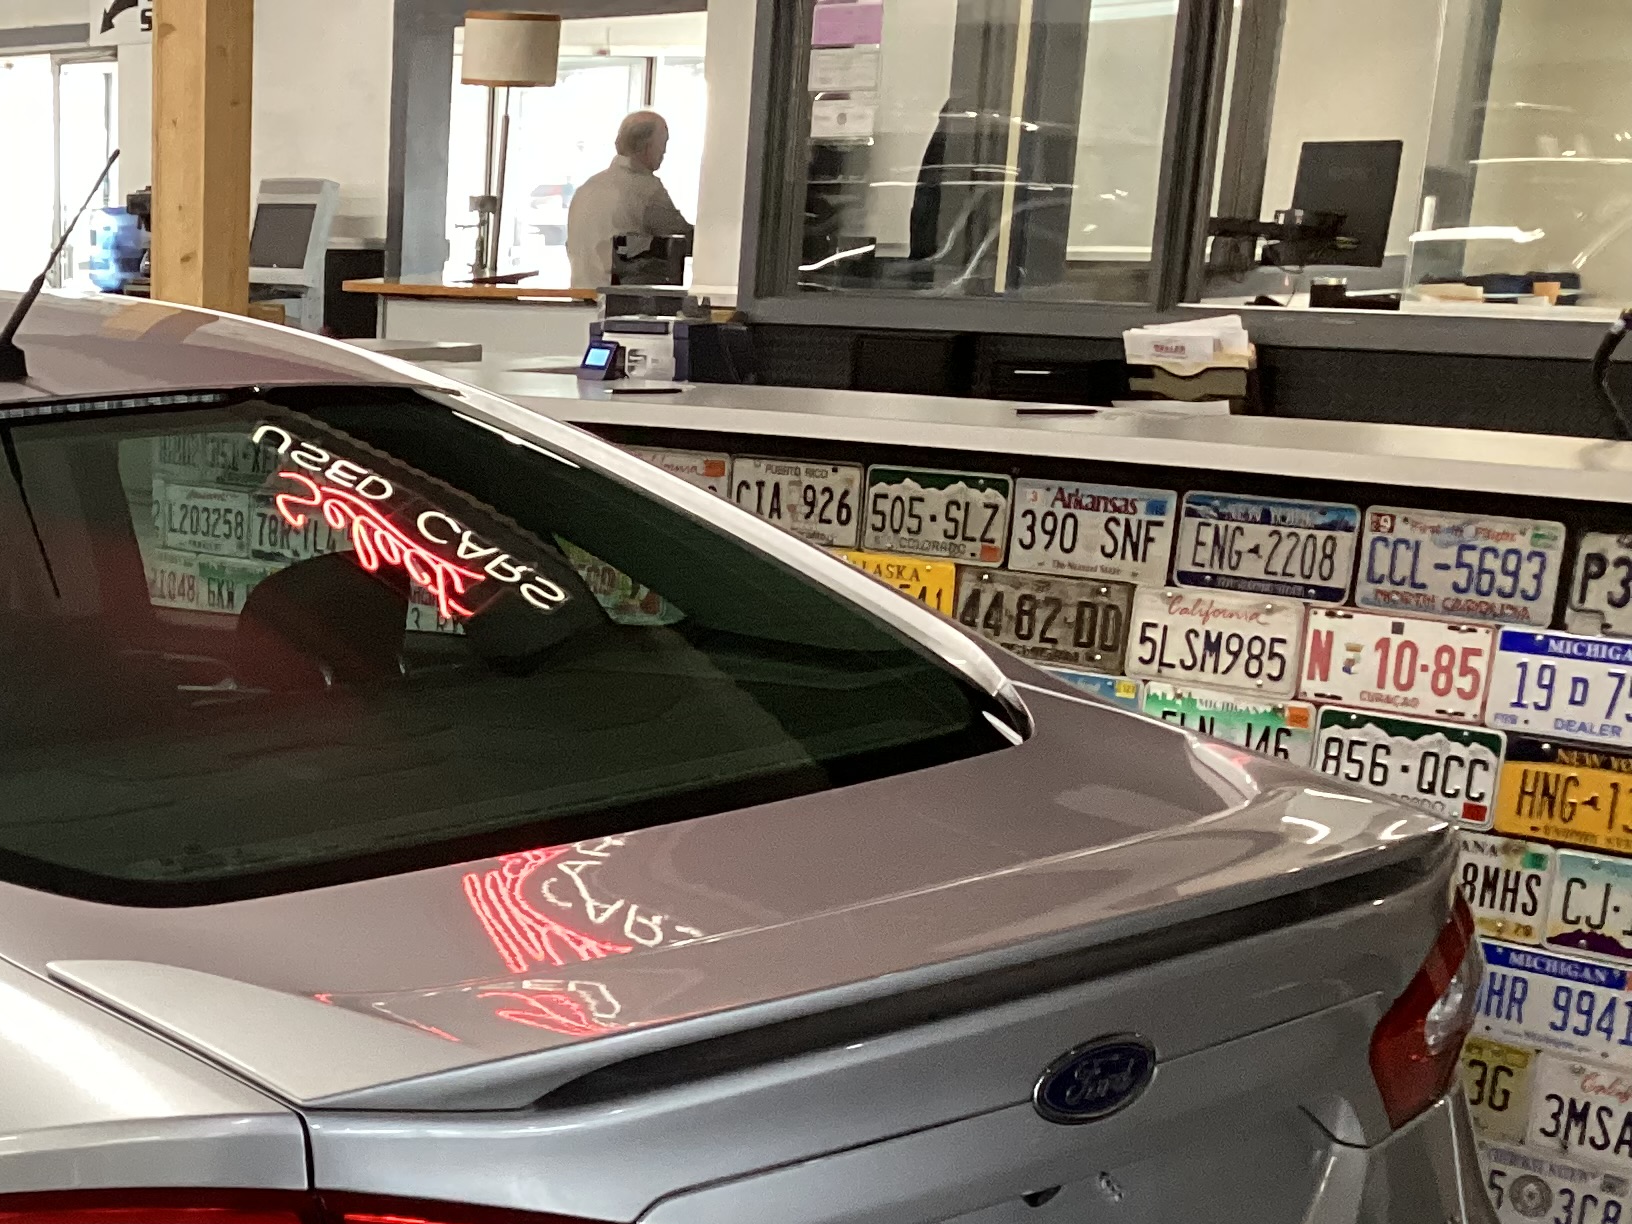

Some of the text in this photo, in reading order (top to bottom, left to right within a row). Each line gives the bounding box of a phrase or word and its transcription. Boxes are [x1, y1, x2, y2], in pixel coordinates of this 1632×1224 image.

[802, 484, 852, 526] 926
[1050, 487, 1138, 516] Arkansas
[1018, 509, 1165, 563] 390 SNF
[852, 559, 921, 583] ASKA
[1168, 595, 1269, 625] California
[1137, 621, 1288, 683] 5LSM985
[1306, 629, 1334, 683] N
[1509, 659, 1557, 712] 19
[1553, 717, 1623, 738] DEALER
[1508, 951, 1608, 983] MICHIGAN
